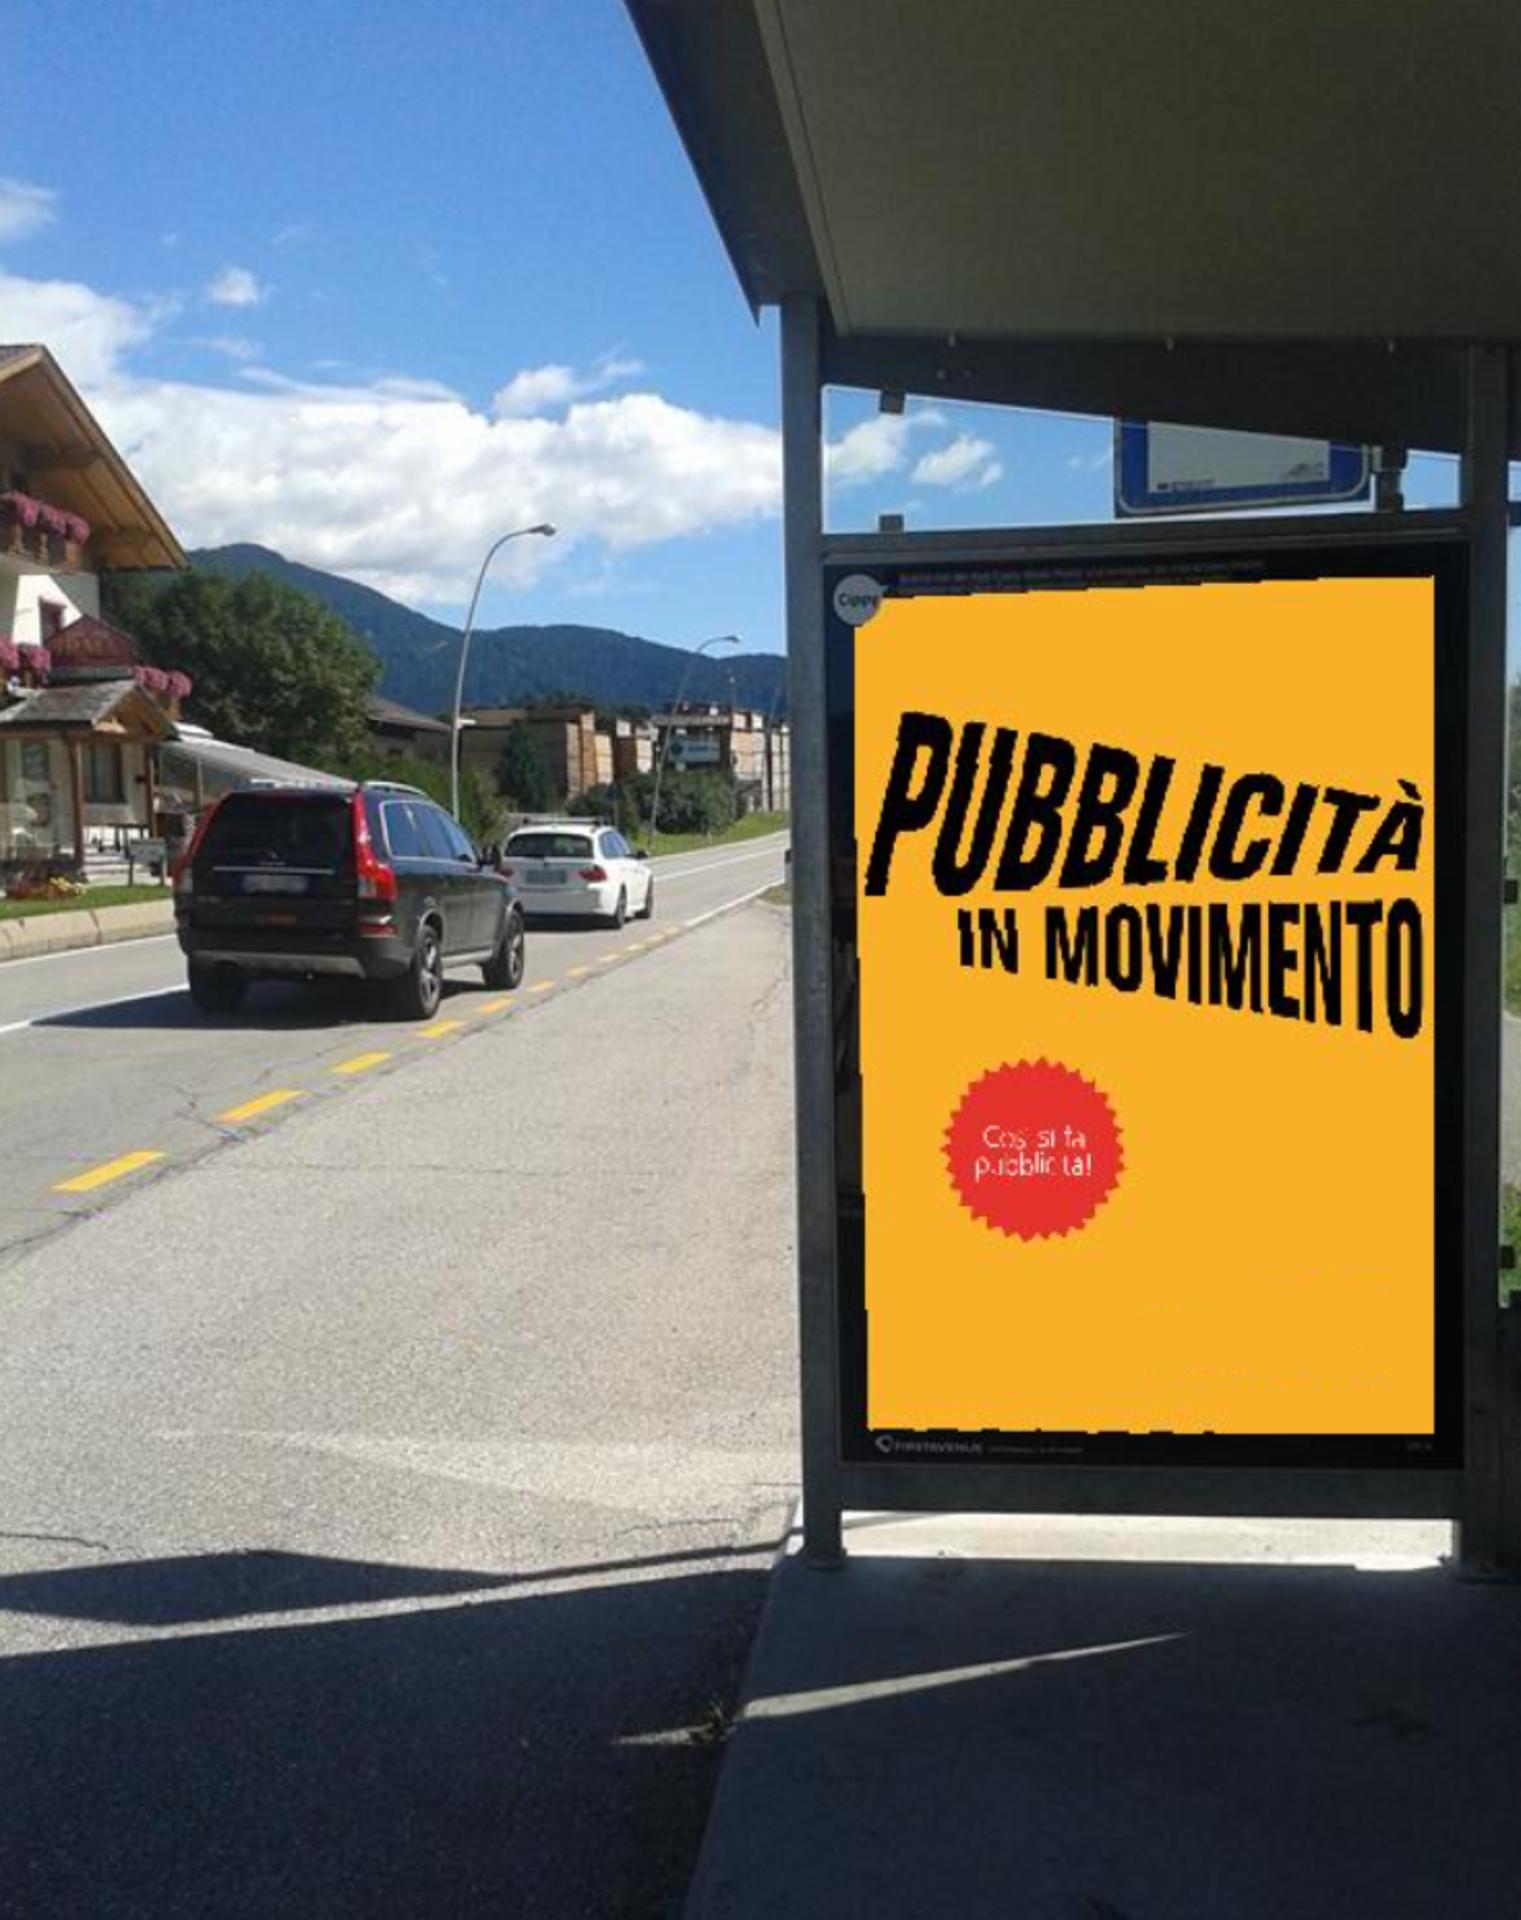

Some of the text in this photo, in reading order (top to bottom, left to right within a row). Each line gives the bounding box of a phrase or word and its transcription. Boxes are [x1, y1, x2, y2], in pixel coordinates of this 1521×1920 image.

[865, 711, 1424, 896] PUBBLICITÀ
[957, 898, 1423, 1039] IN MOVIMENTO
